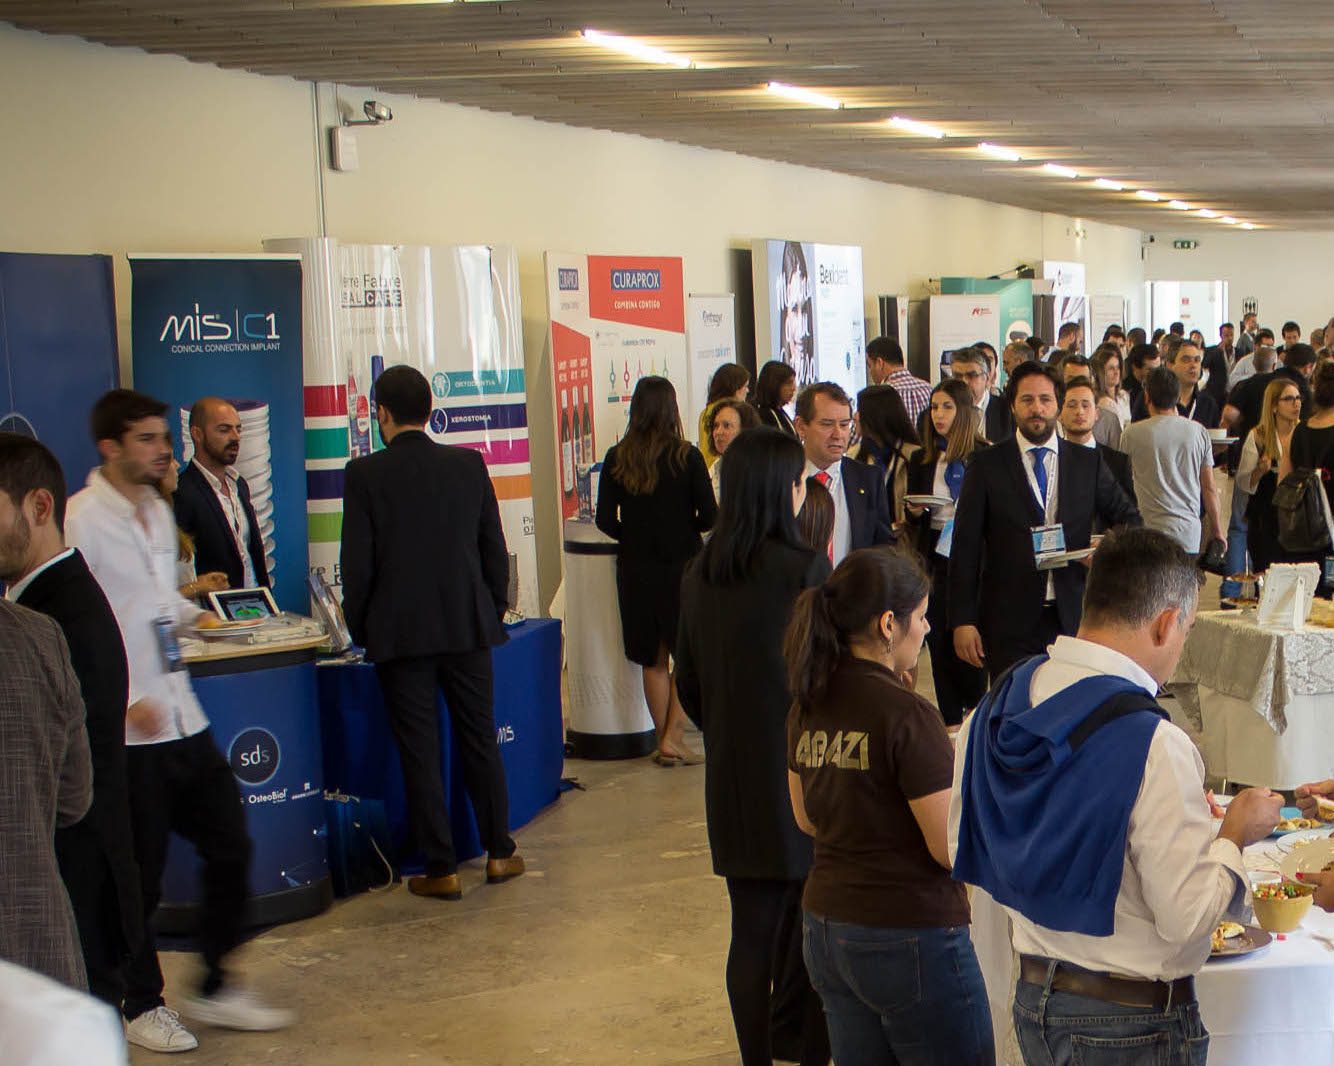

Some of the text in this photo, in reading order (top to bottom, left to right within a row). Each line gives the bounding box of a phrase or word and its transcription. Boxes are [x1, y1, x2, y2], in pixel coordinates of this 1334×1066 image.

[613, 271, 660, 289] CURAPROX
[171, 342, 281, 354] CONICAL CONNECTION IMPLANT
[451, 414, 492, 423] XEROSTOMIA
[240, 744, 270, 767] sds
[248, 788, 287, 804] OsteoBiol
